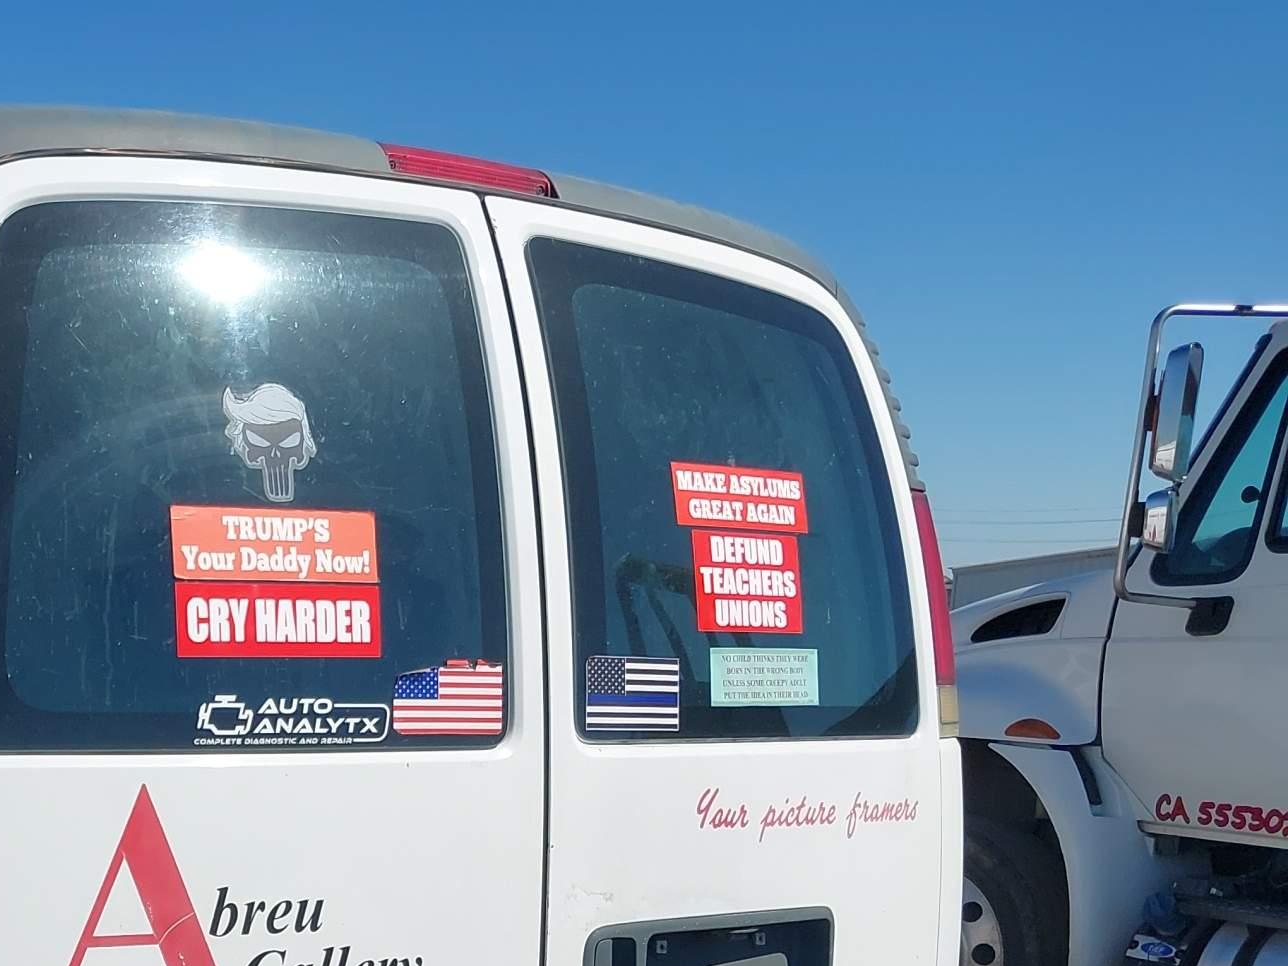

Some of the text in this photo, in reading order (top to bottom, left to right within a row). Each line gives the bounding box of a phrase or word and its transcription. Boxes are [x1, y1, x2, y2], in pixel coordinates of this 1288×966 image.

[676, 470, 802, 500] MAKE ASYLUMS
[689, 499, 795, 526] GREAT AGAIN
[222, 515, 330, 542] TRUMP'S
[181, 545, 370, 579] Your Daddy Now!
[710, 536, 784, 566] DEFUND
[700, 567, 797, 599] TEACHERS
[186, 597, 371, 643] CRY HARDER
[714, 599, 787, 628] UNIONS
[257, 698, 334, 714] AUTO
[253, 717, 380, 734] ANALYTX
[193, 737, 353, 746] COMPLETE DIAGNOSTIC AND REPAIR
[696, 788, 919, 843] Your picture framers
[1155, 793, 1190, 824] CA
